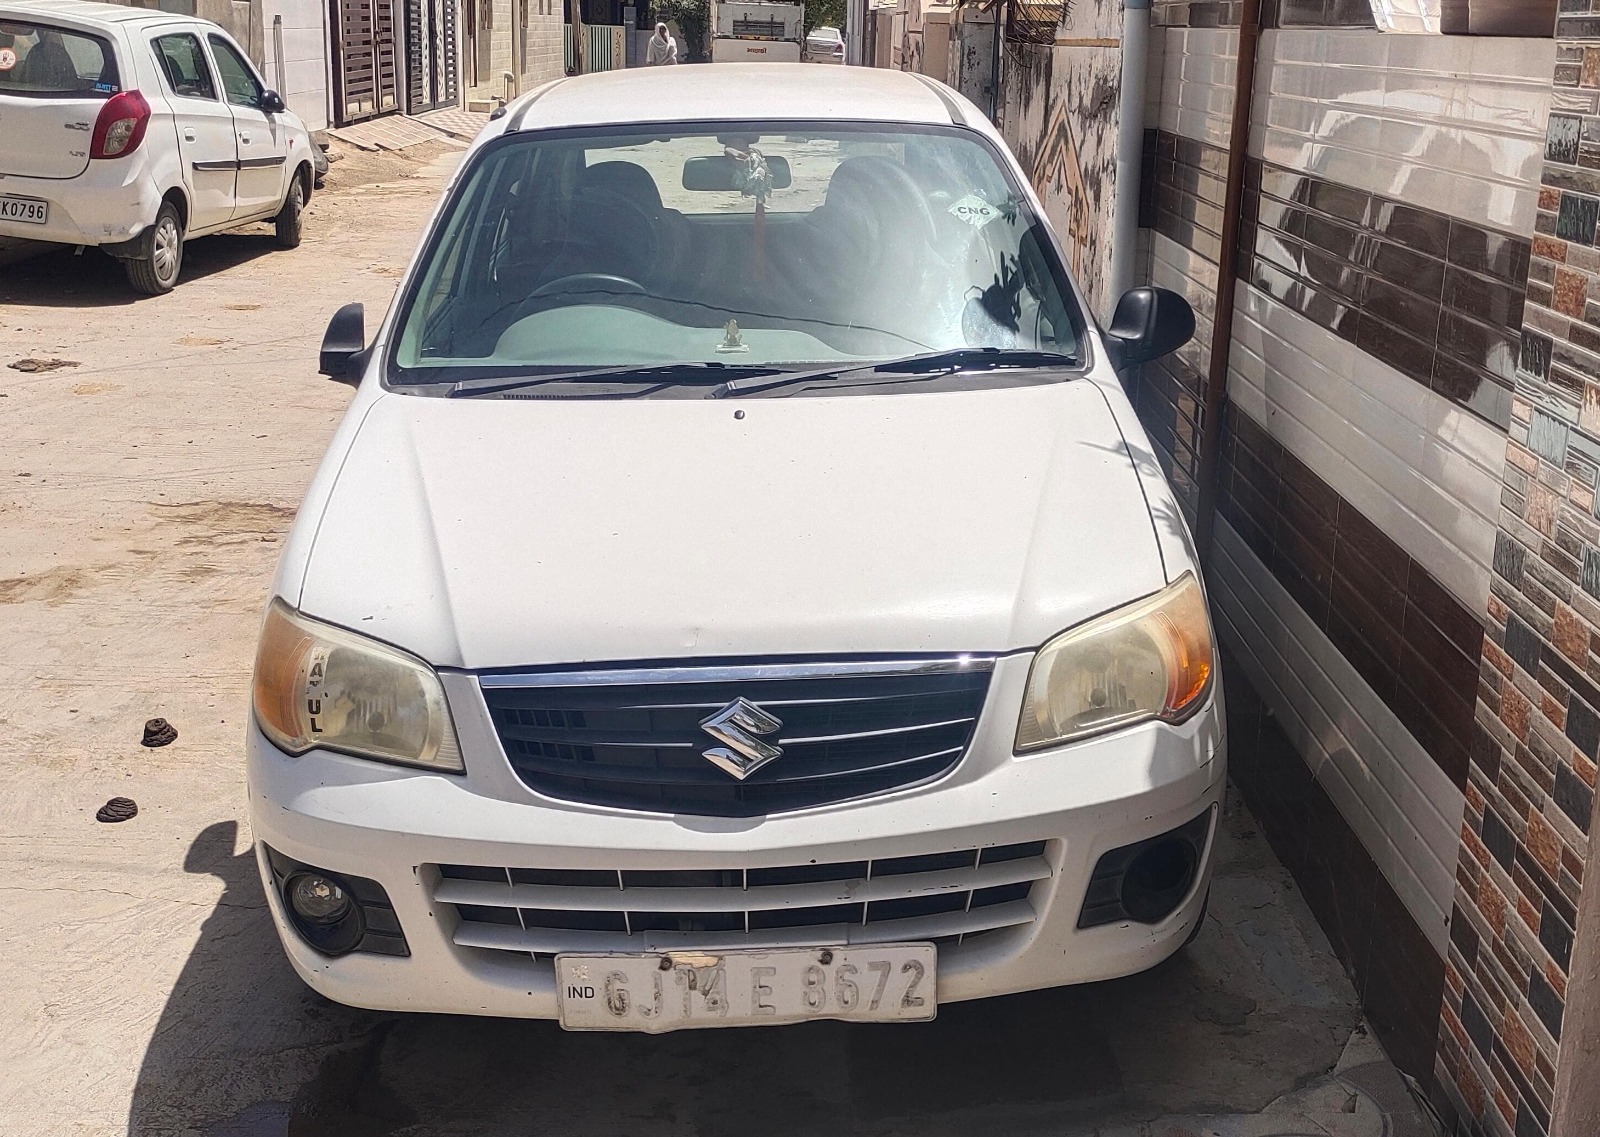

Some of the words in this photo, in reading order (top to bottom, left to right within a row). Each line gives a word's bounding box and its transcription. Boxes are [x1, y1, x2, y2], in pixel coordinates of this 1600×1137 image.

[0, 201, 44, 219] K0796
[957, 206, 991, 216] CNG
[568, 986, 595, 999] IND
[751, 966, 777, 1016] E
[801, 959, 926, 1014] 8672
